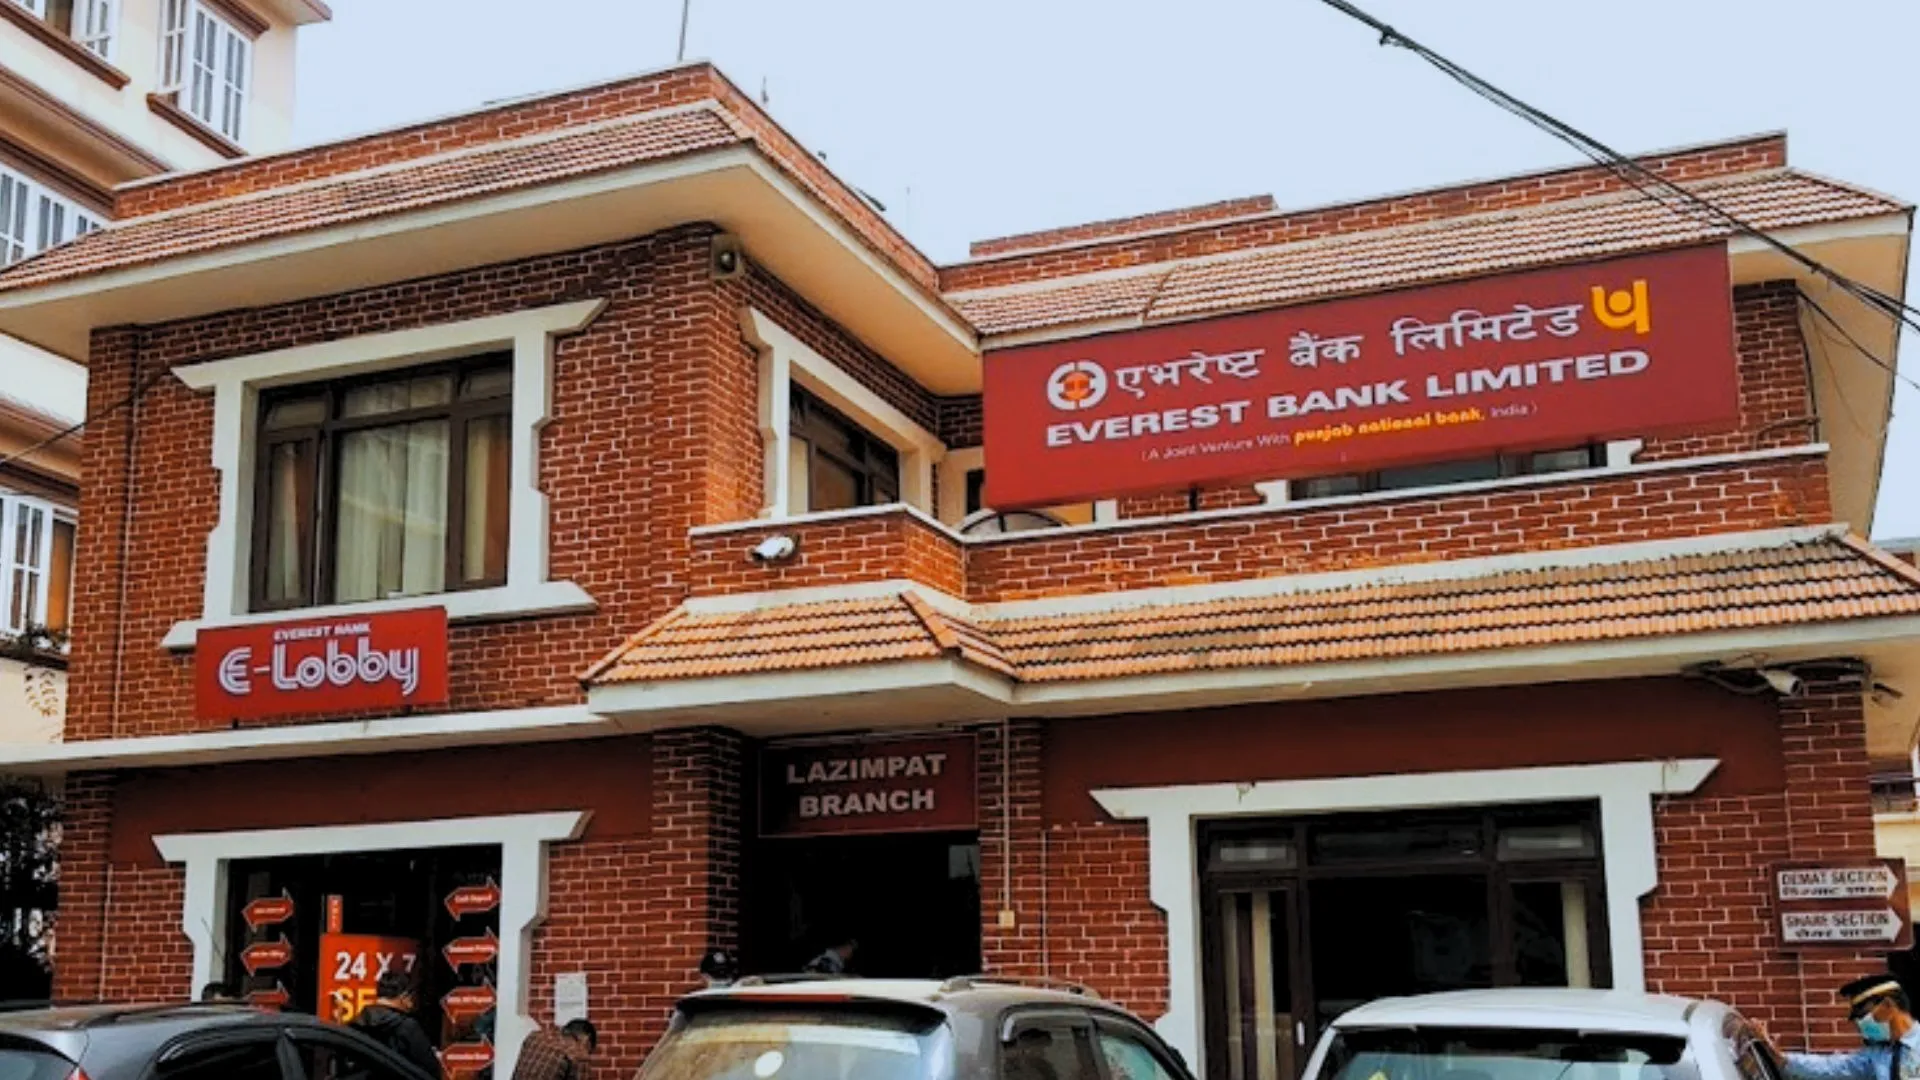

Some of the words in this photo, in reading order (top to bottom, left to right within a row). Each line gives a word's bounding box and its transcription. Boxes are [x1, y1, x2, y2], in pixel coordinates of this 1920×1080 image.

[1288, 330, 1364, 369] बैंक
[1389, 303, 1583, 356] लिमिटेड
[1046, 400, 1251, 447] EVEREST
[1266, 379, 1409, 418] BANK
[1425, 350, 1650, 398] LIMITED
[1163, 442, 1197, 460] Joint
[1200, 438, 1254, 454] Venture
[1256, 430, 1291, 448] With
[1294, 423, 1352, 447] punjab
[1358, 413, 1431, 434] national
[274, 625, 331, 641] EVEREST
[334, 622, 370, 636] BANK
[786, 753, 947, 784] LAZIMPAT
[799, 789, 935, 817] BRANCH
[1831, 913, 1890, 926] SECTION
[333, 951, 368, 981] 24
[401, 953, 417, 973] 7
